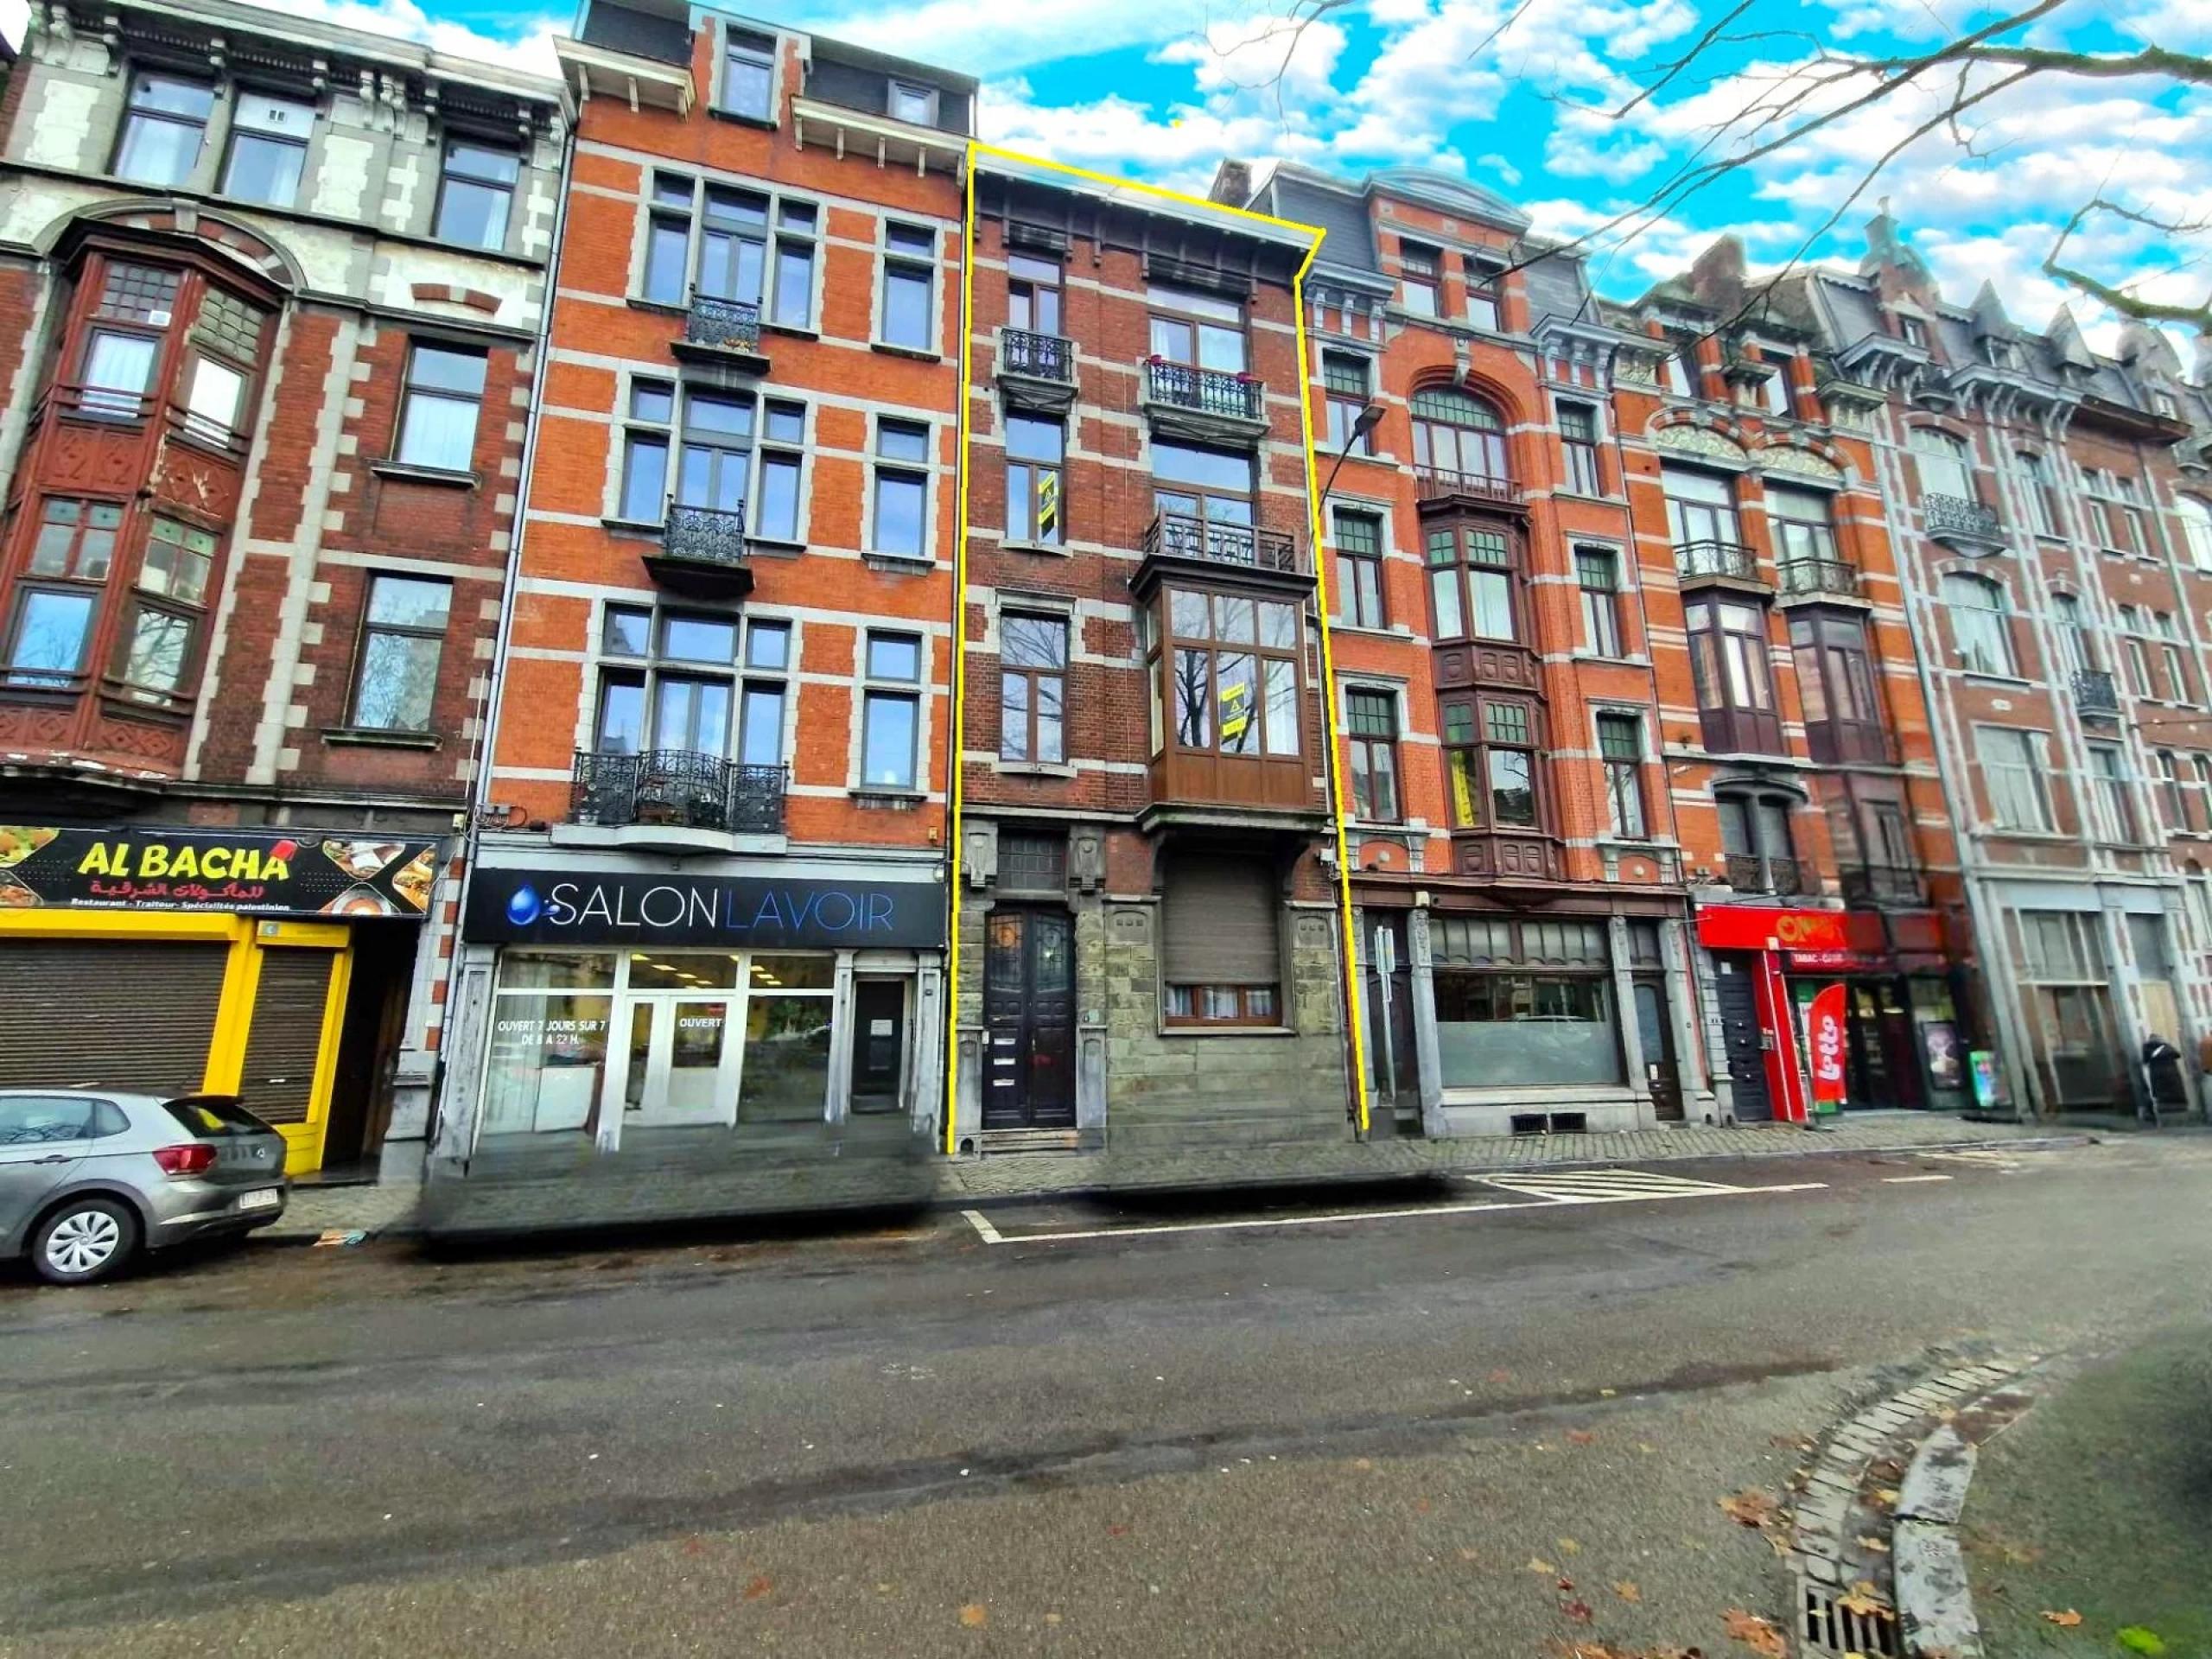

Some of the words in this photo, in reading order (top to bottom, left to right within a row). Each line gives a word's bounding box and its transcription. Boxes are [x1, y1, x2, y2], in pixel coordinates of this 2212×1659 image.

[77, 842, 130, 876] AL
[138, 844, 289, 880] BACHA
[90, 880, 168, 899] الشرقية
[71, 898, 126, 907] Restaurant
[136, 899, 174, 909] Traiteur
[550, 883, 718, 929] SALON
[726, 887, 893, 931] LAVOIR
[498, 1020, 535, 1032] OUVERT
[545, 1020, 576, 1031] JOURS
[579, 1020, 597, 1031] SUR
[599, 1020, 606, 1031] 7
[679, 1018, 722, 1027] OUVERT
[521, 1033, 534, 1045] DE
